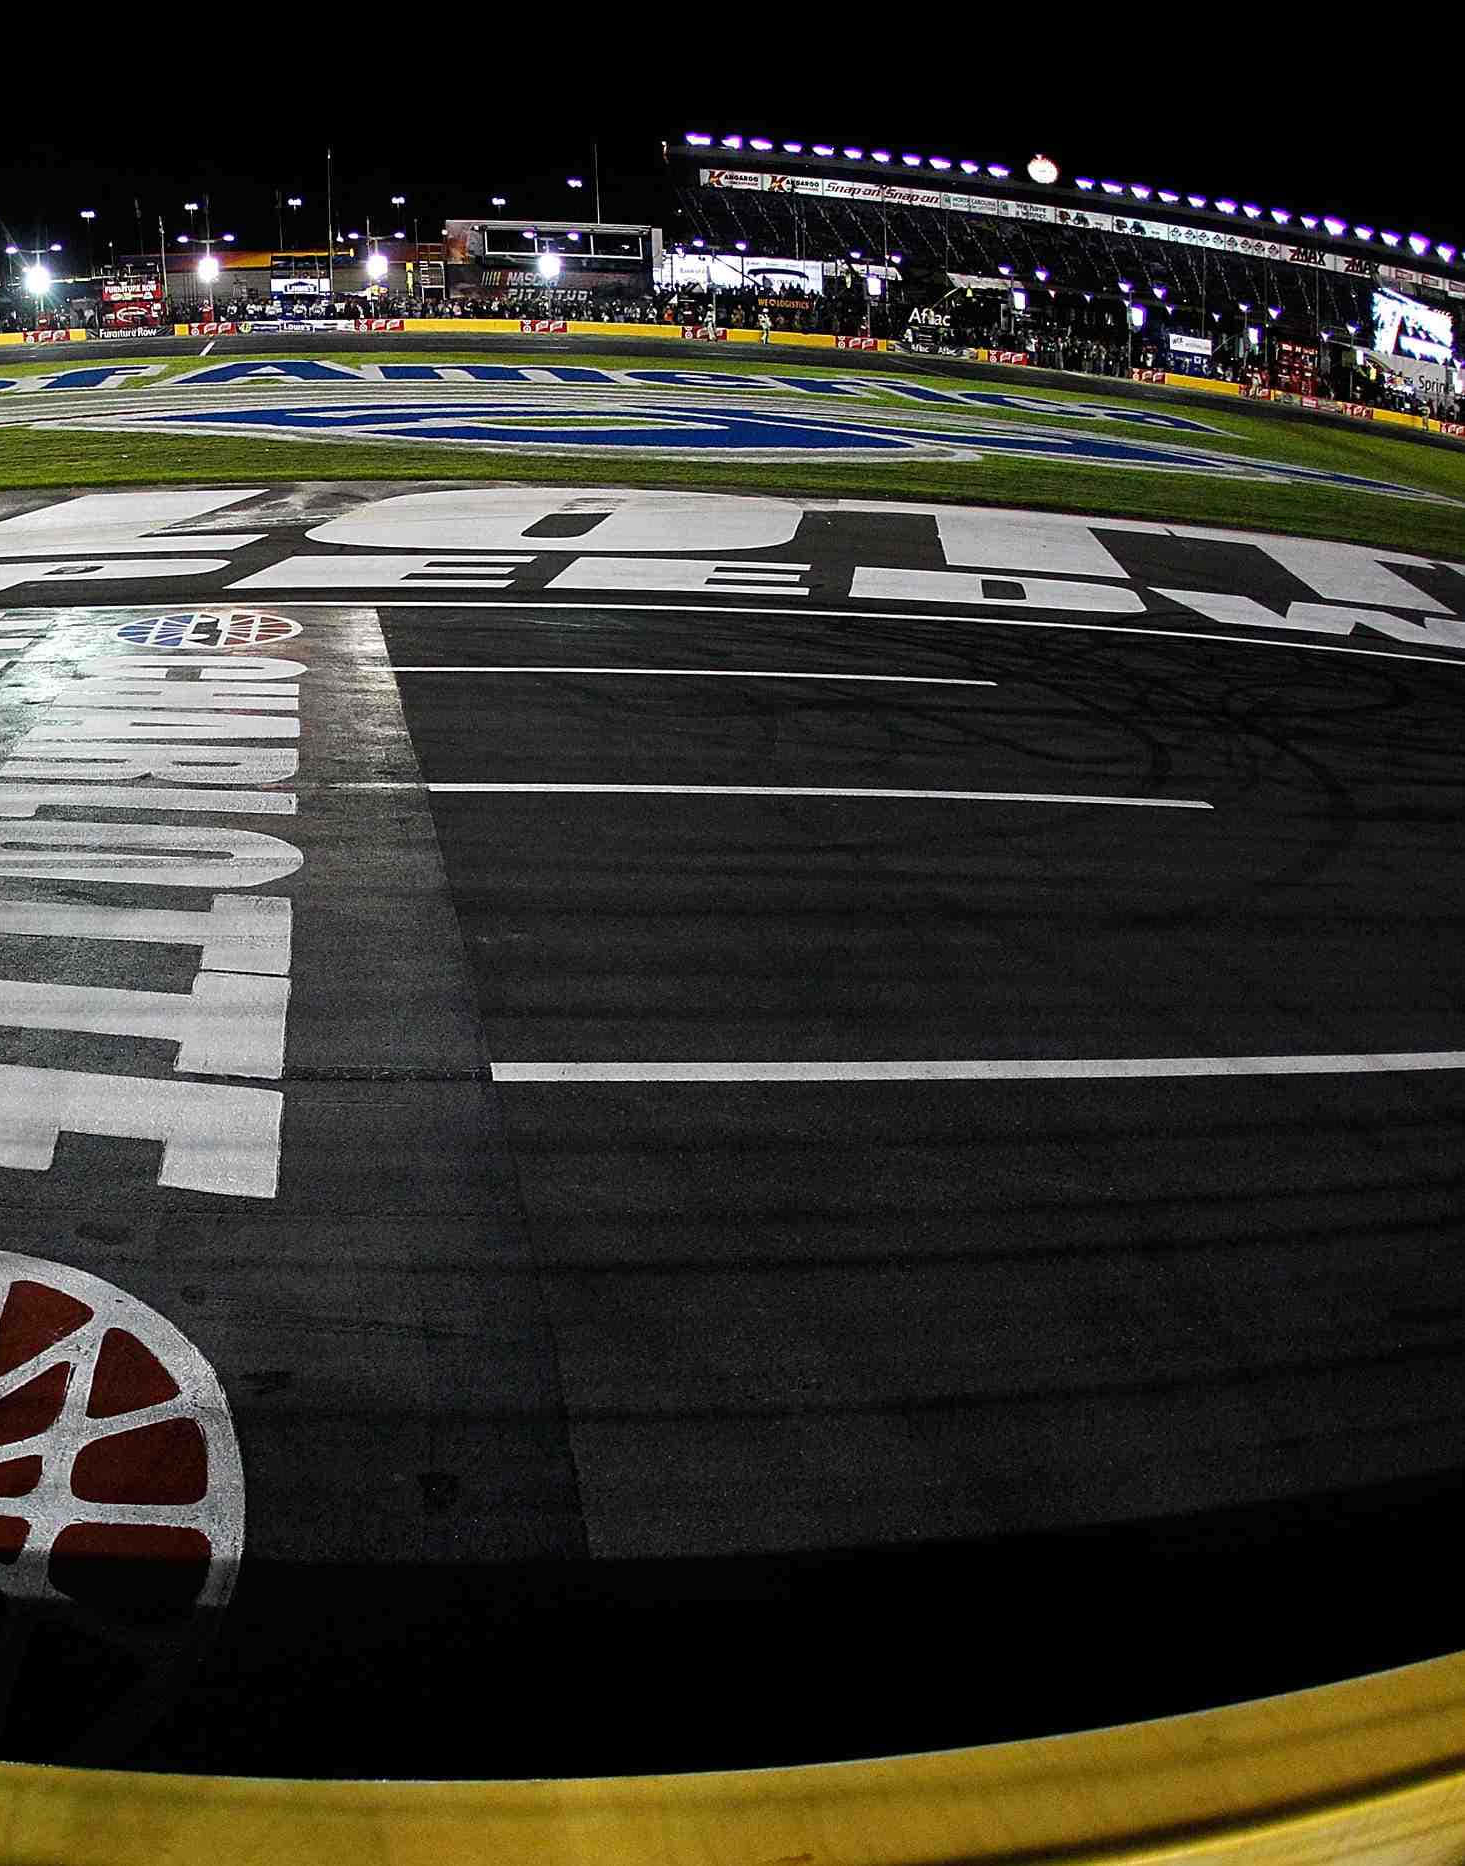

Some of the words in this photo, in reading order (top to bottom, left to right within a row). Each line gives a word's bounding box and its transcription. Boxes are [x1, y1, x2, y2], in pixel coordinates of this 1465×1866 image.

[824, 182, 883, 197] Snap-on
[884, 188, 940, 204] Snap-on
[907, 306, 951, 327] Afac
[1418, 375, 1447, 394] Sprin
[164, 360, 1234, 435] America
